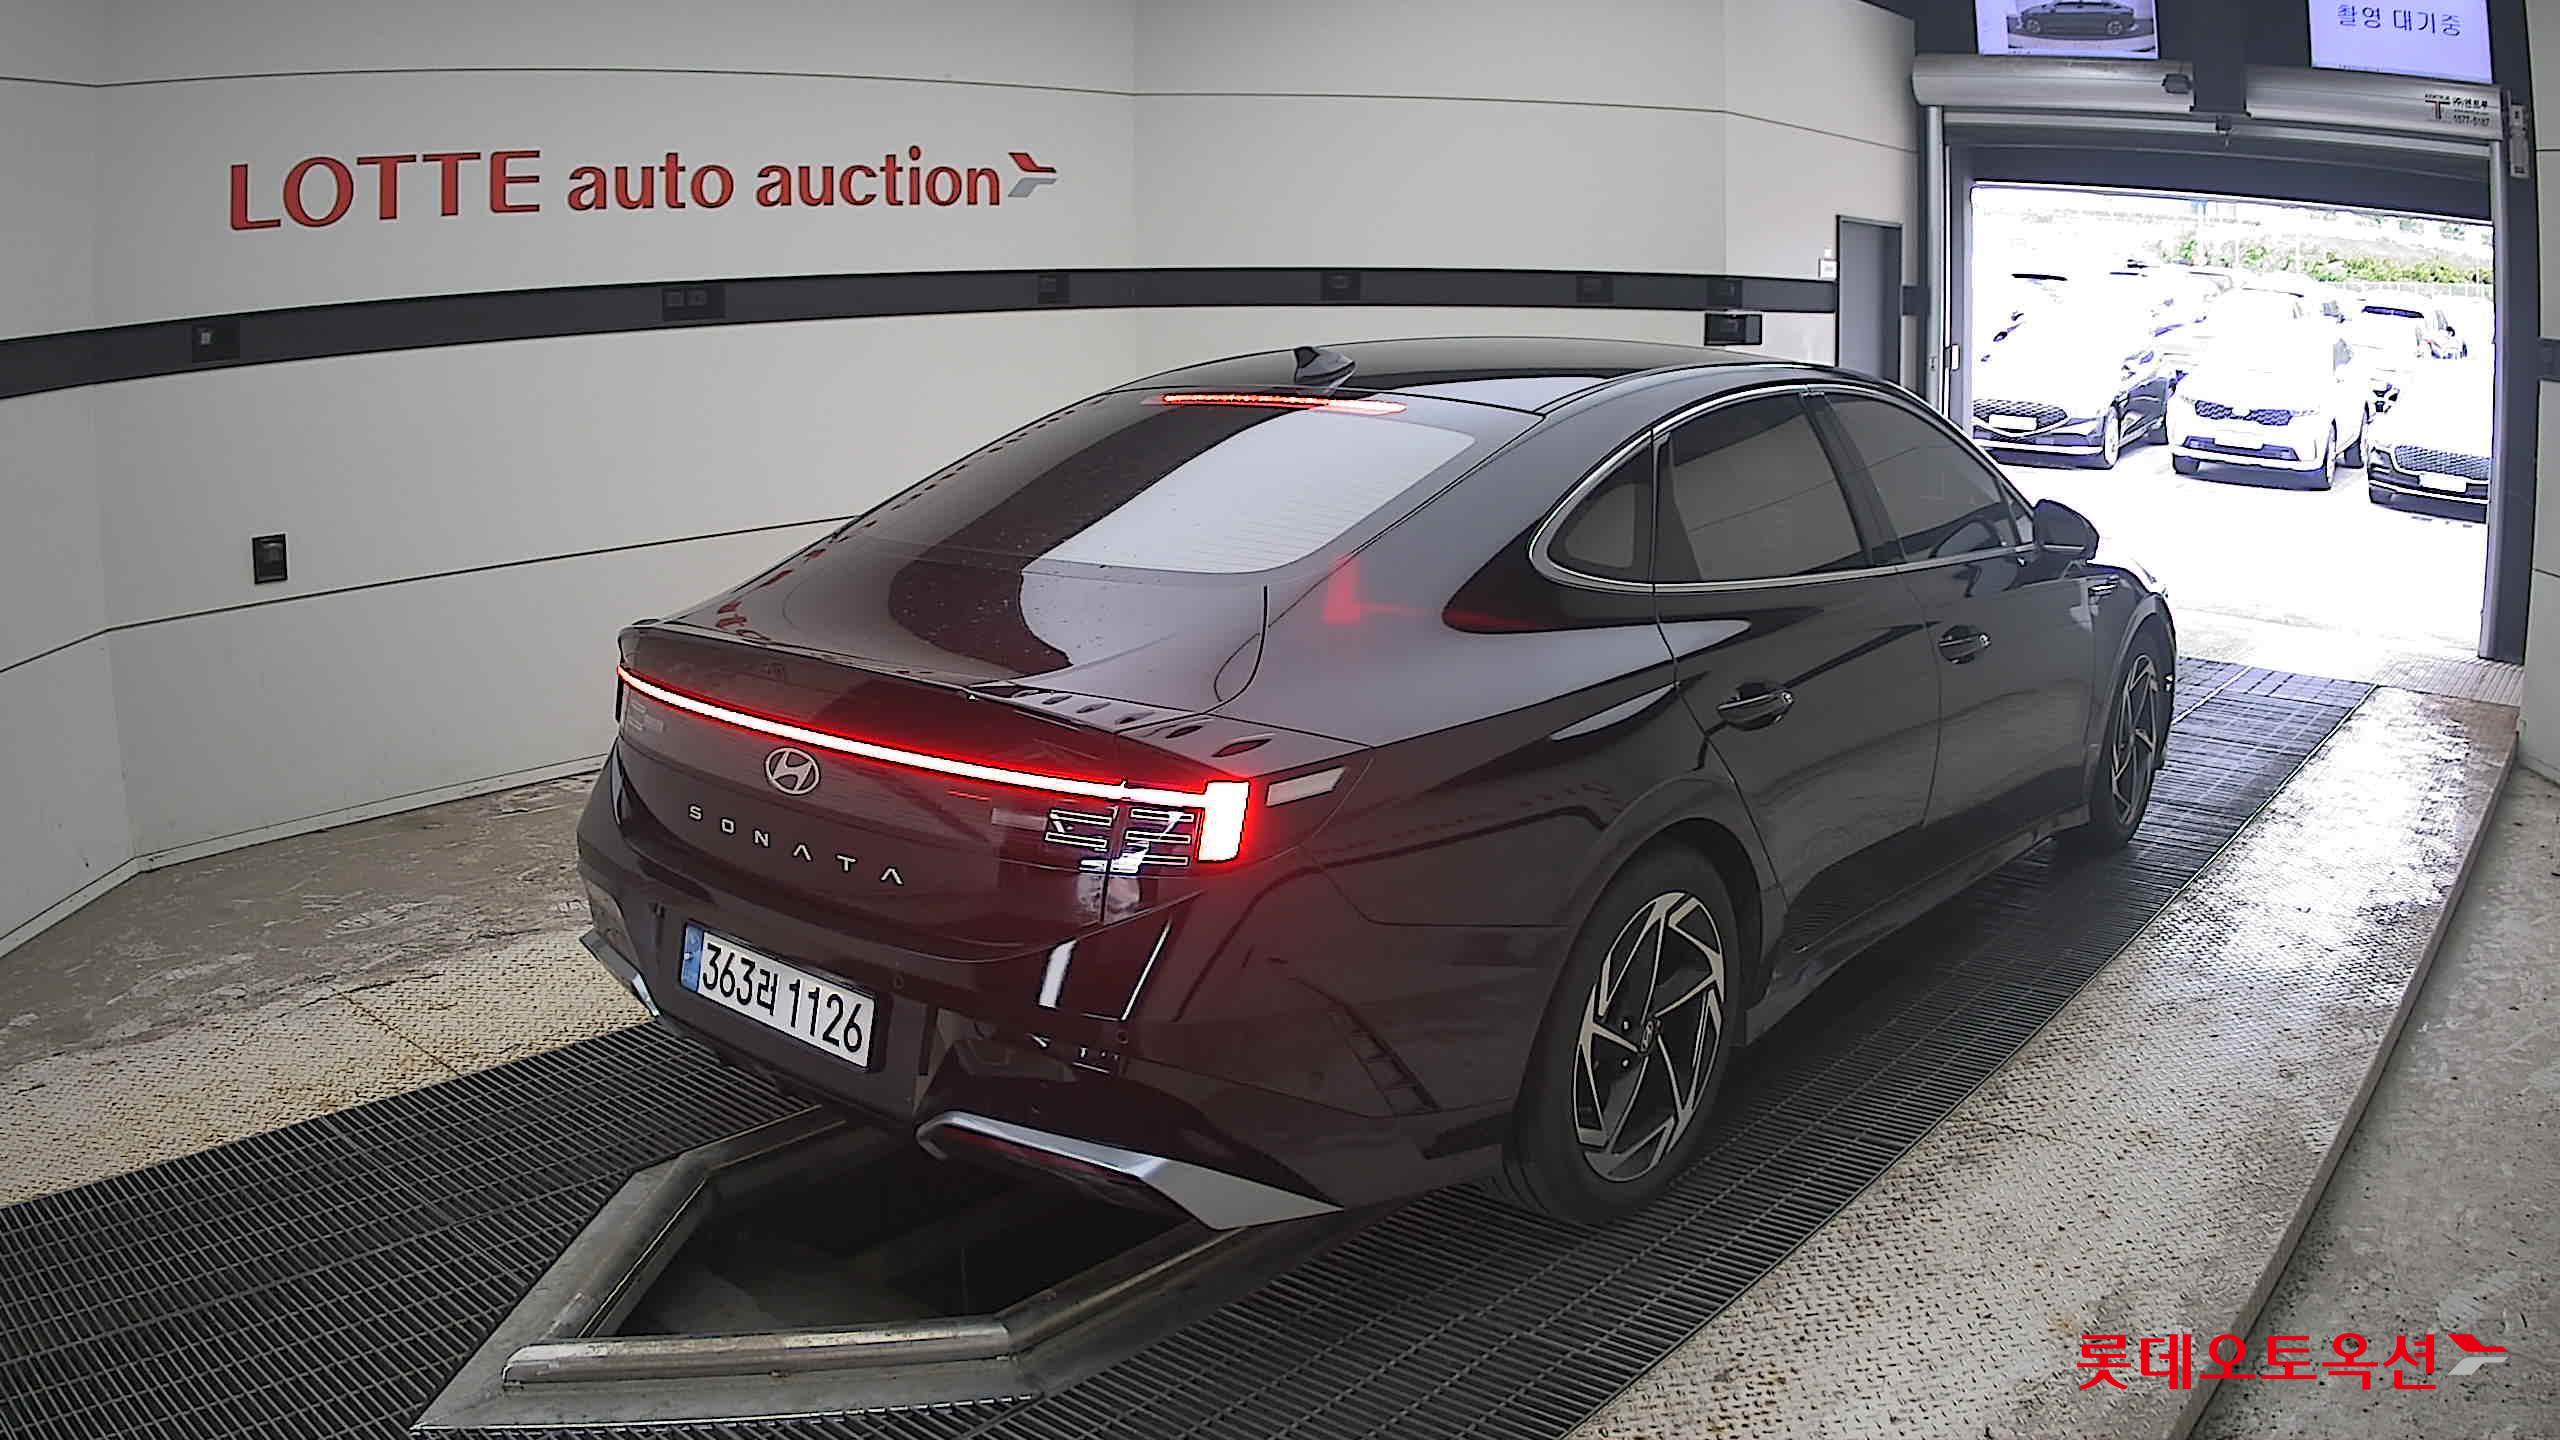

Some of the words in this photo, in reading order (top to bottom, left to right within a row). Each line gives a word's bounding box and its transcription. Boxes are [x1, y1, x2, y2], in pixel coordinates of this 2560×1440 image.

[2337, 4, 2382, 29] 촬영
[2393, 9, 2461, 37] 대기중
[230, 149, 541, 231] LOTTE
[567, 152, 734, 211] auto
[755, 145, 1002, 208] auction
[688, 804, 904, 886] SONATA
[789, 978, 863, 1053] 1126
